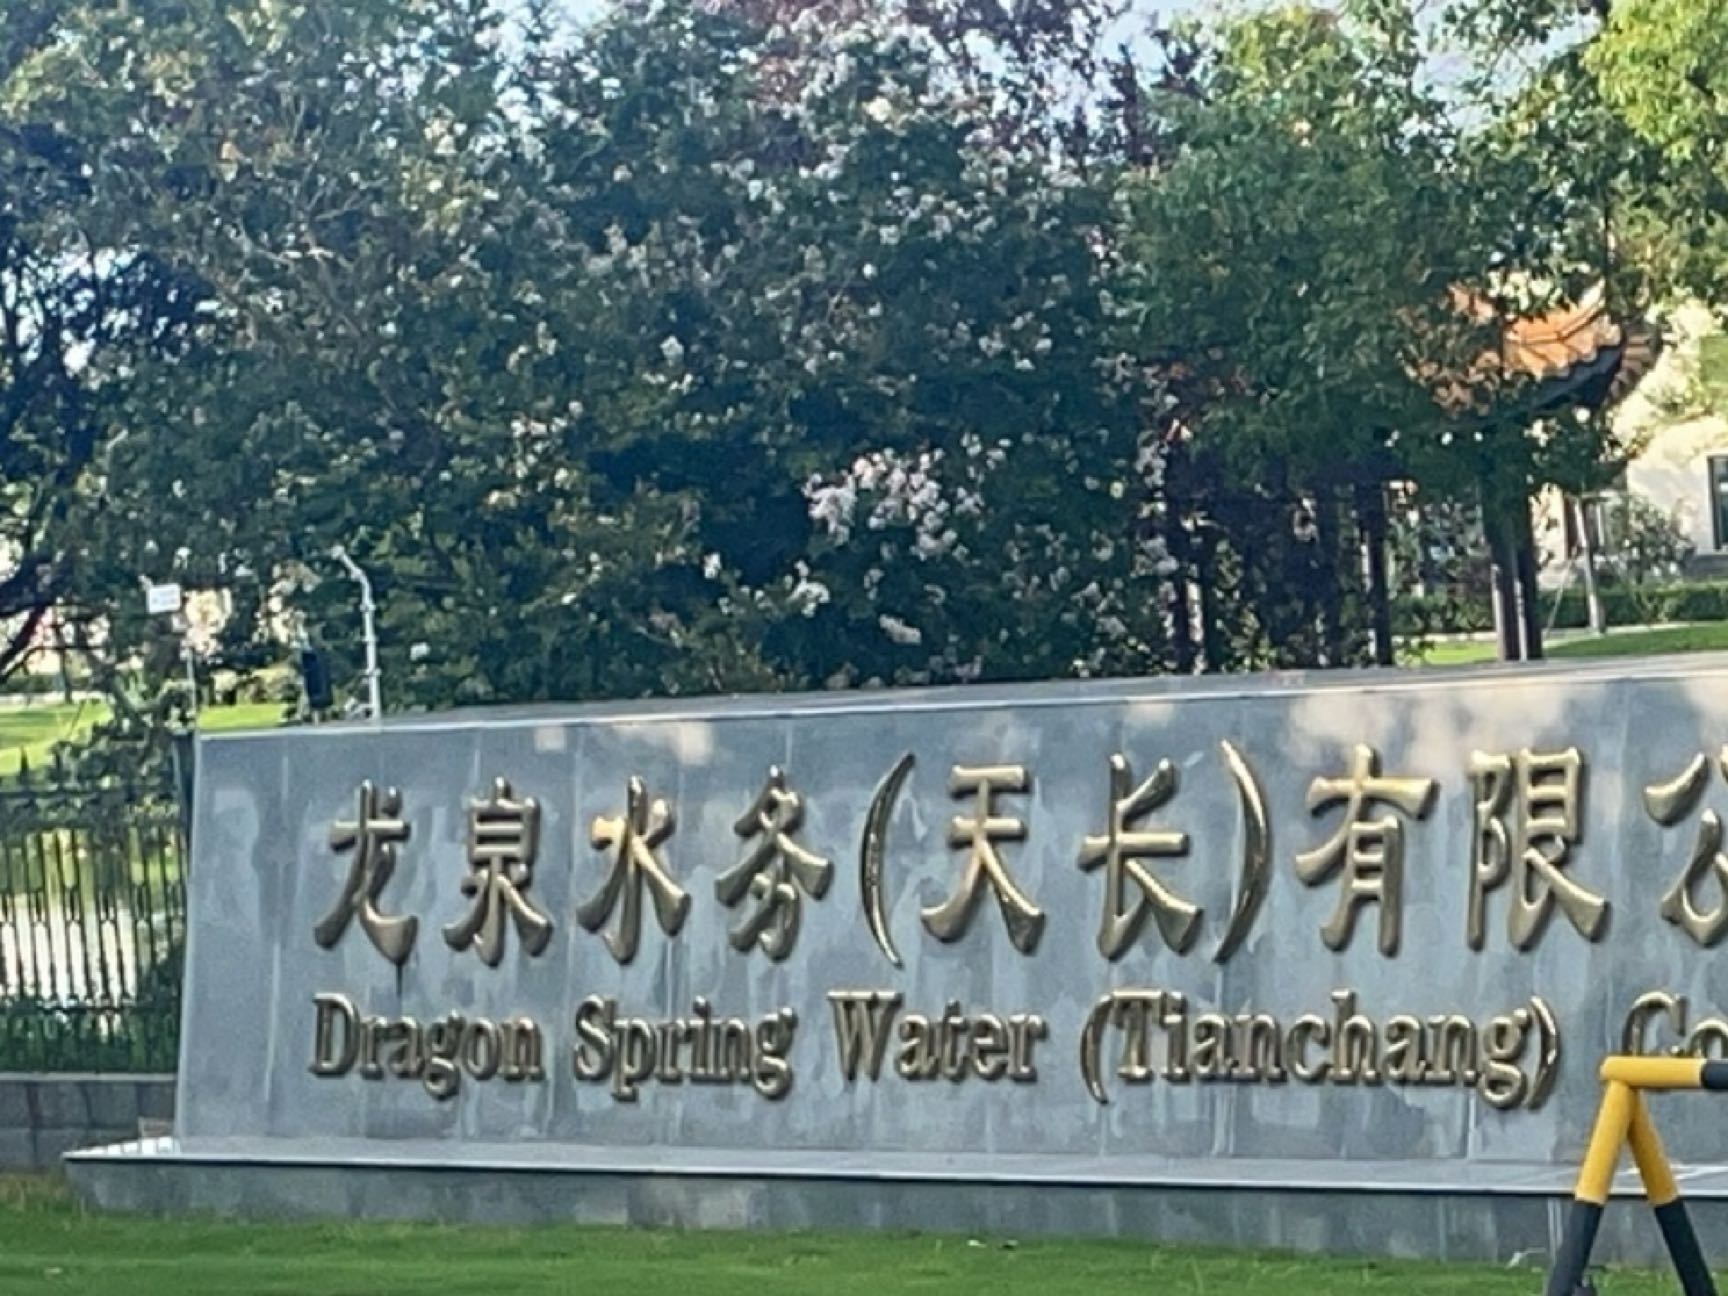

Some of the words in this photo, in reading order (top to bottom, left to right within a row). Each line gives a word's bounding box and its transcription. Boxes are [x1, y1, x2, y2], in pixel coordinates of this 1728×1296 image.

[309, 992, 545, 1099] Dragon
[573, 994, 796, 1101] Spring
[827, 989, 1048, 1086] Water
[1079, 987, 1562, 1109] (Tianchang)
